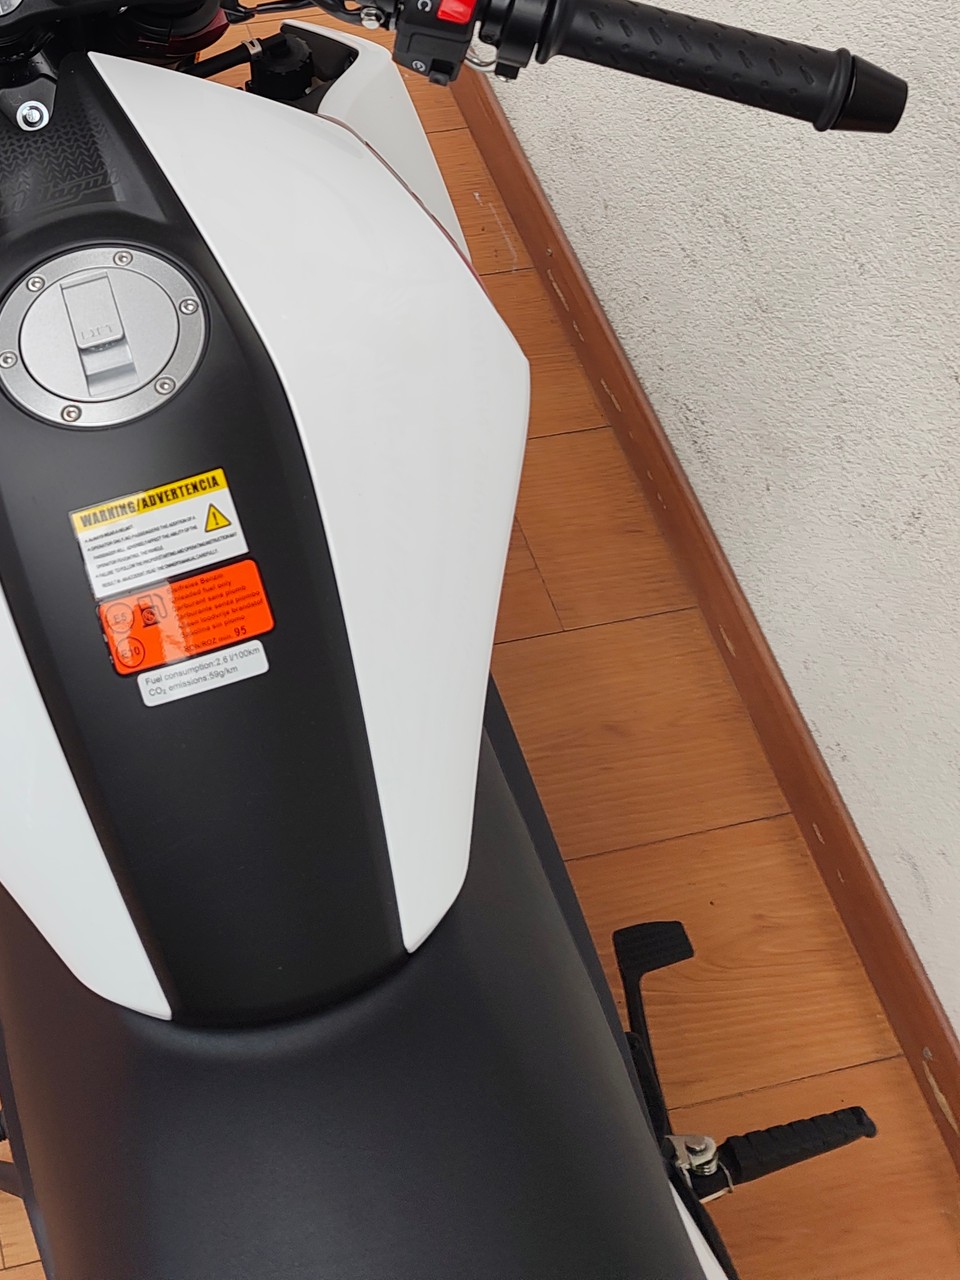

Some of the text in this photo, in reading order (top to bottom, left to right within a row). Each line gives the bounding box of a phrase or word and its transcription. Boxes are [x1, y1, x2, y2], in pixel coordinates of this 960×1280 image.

[80, 474, 220, 528] WARNING/ADVERTENCIA
[233, 625, 247, 637] 95
[145, 673, 163, 686] Fuel
